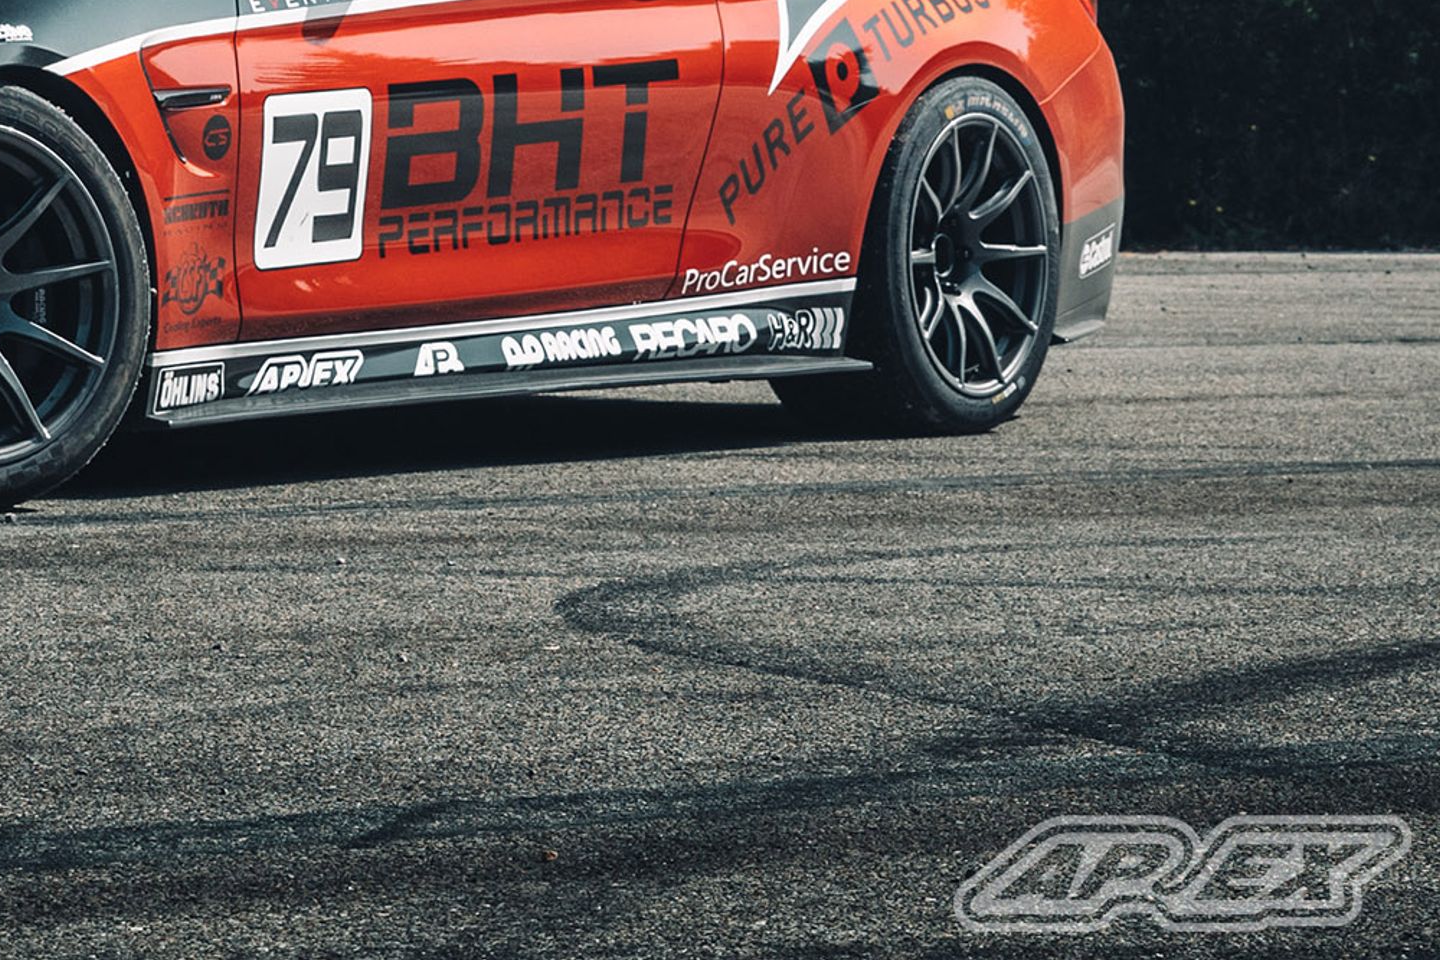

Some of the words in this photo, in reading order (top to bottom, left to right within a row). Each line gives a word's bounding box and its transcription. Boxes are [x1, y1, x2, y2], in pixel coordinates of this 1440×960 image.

[380, 59, 680, 210] BHT
[717, 88, 814, 225] PURE
[264, 110, 363, 248] 79
[379, 185, 674, 259] PERFORMANCE
[682, 247, 851, 294] ProCarService
[540, 326, 622, 363] RACING
[629, 313, 758, 356] RECARO
[767, 309, 812, 351] H&R
[160, 370, 220, 409] ÖHLINS
[250, 353, 360, 395] APEX
